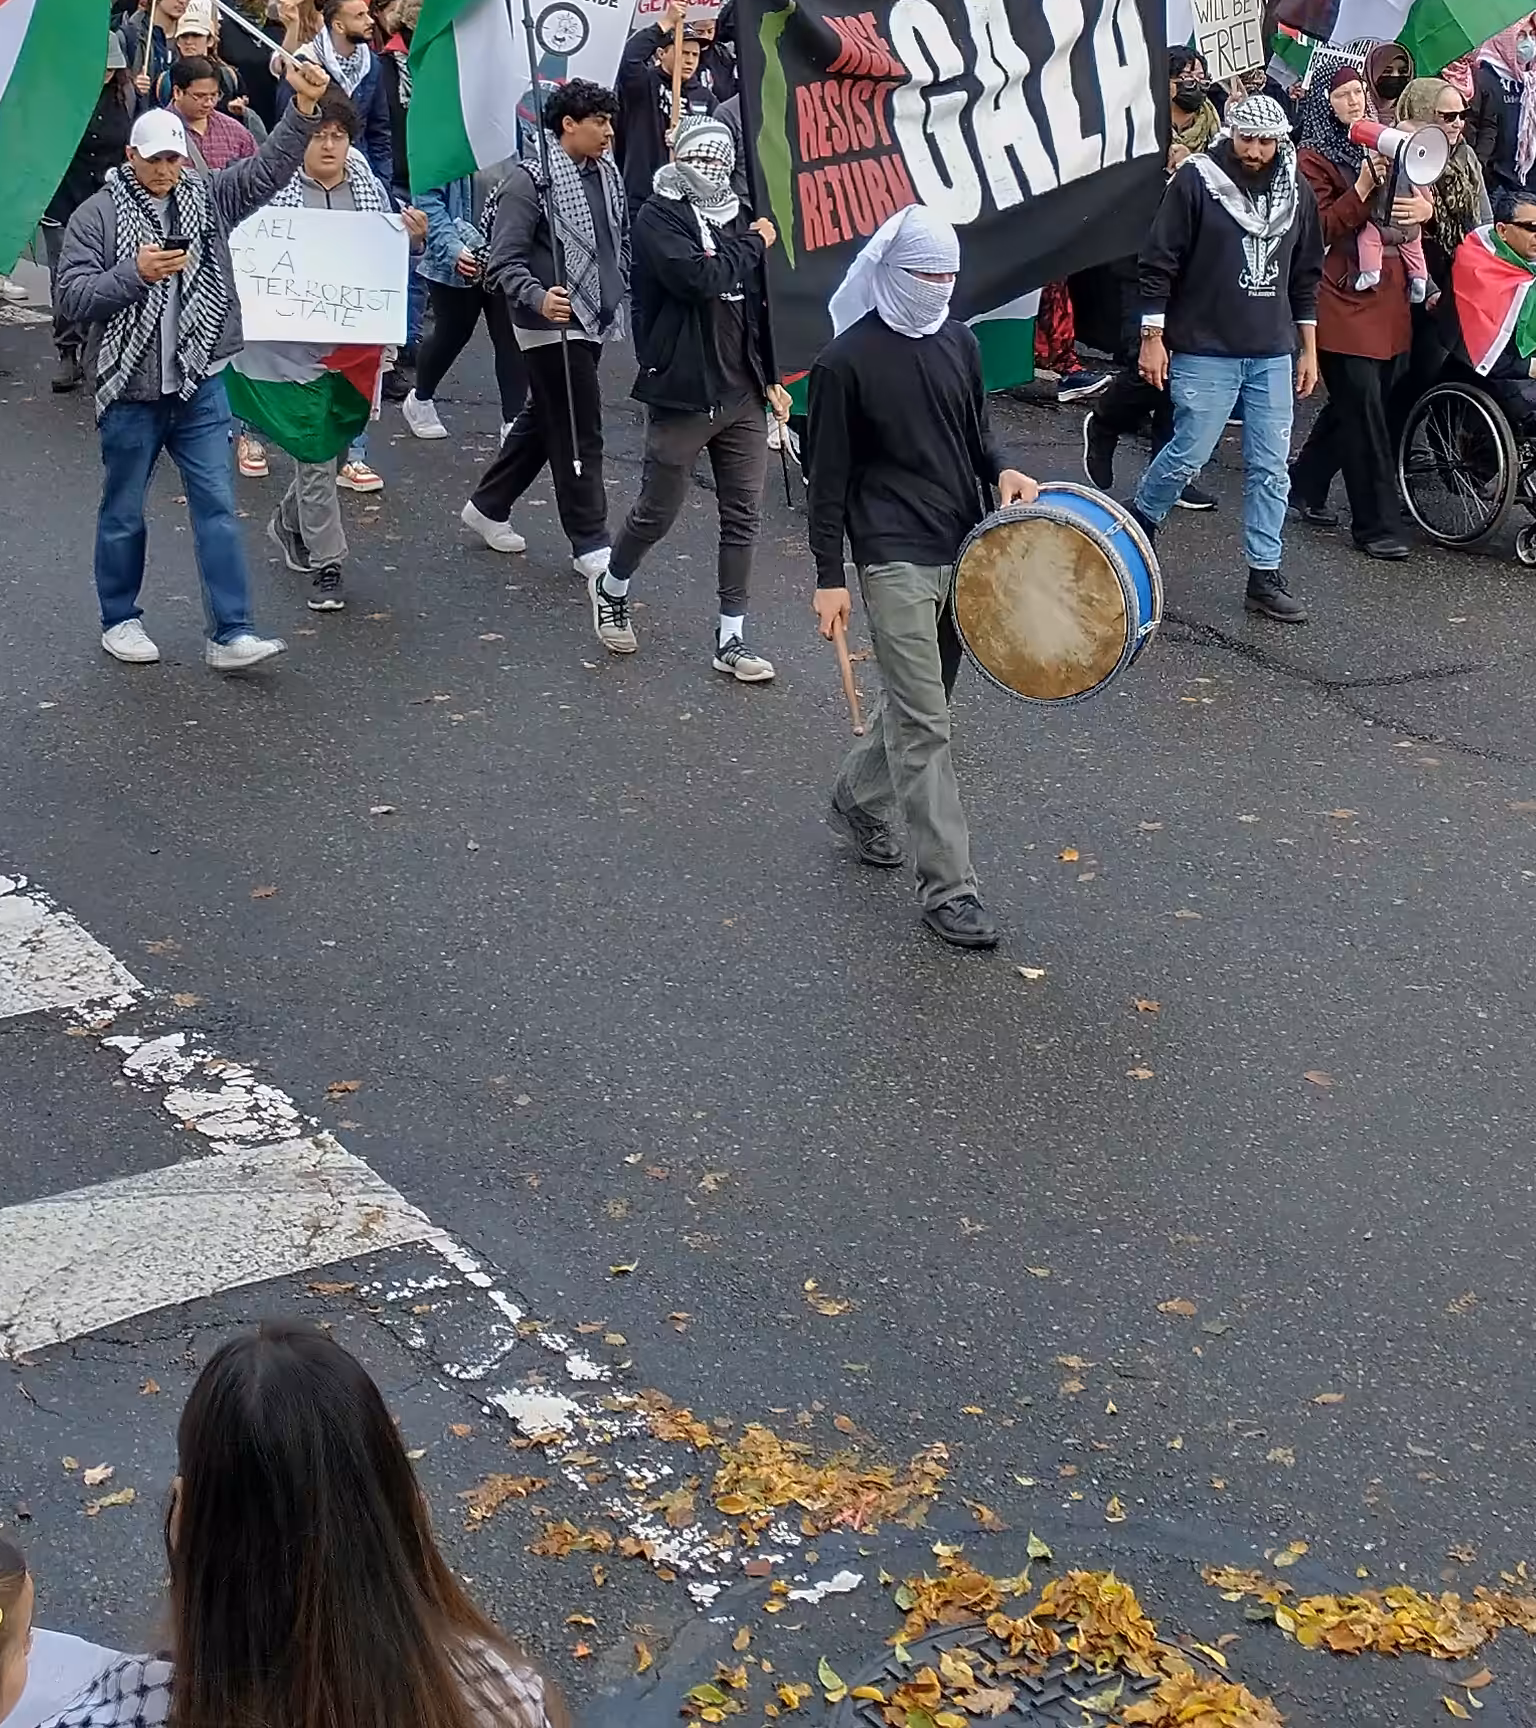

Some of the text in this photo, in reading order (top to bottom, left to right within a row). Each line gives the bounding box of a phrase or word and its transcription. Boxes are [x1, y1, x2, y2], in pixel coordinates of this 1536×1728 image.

[1199, 18, 1260, 75] FREE
[795, 79, 898, 163] RESIST
[798, 153, 918, 252] RETURN
[238, 218, 297, 241] AEL
[230, 247, 296, 274] IS A
[249, 274, 401, 312] TERRORIST
[275, 298, 364, 329] STATE
